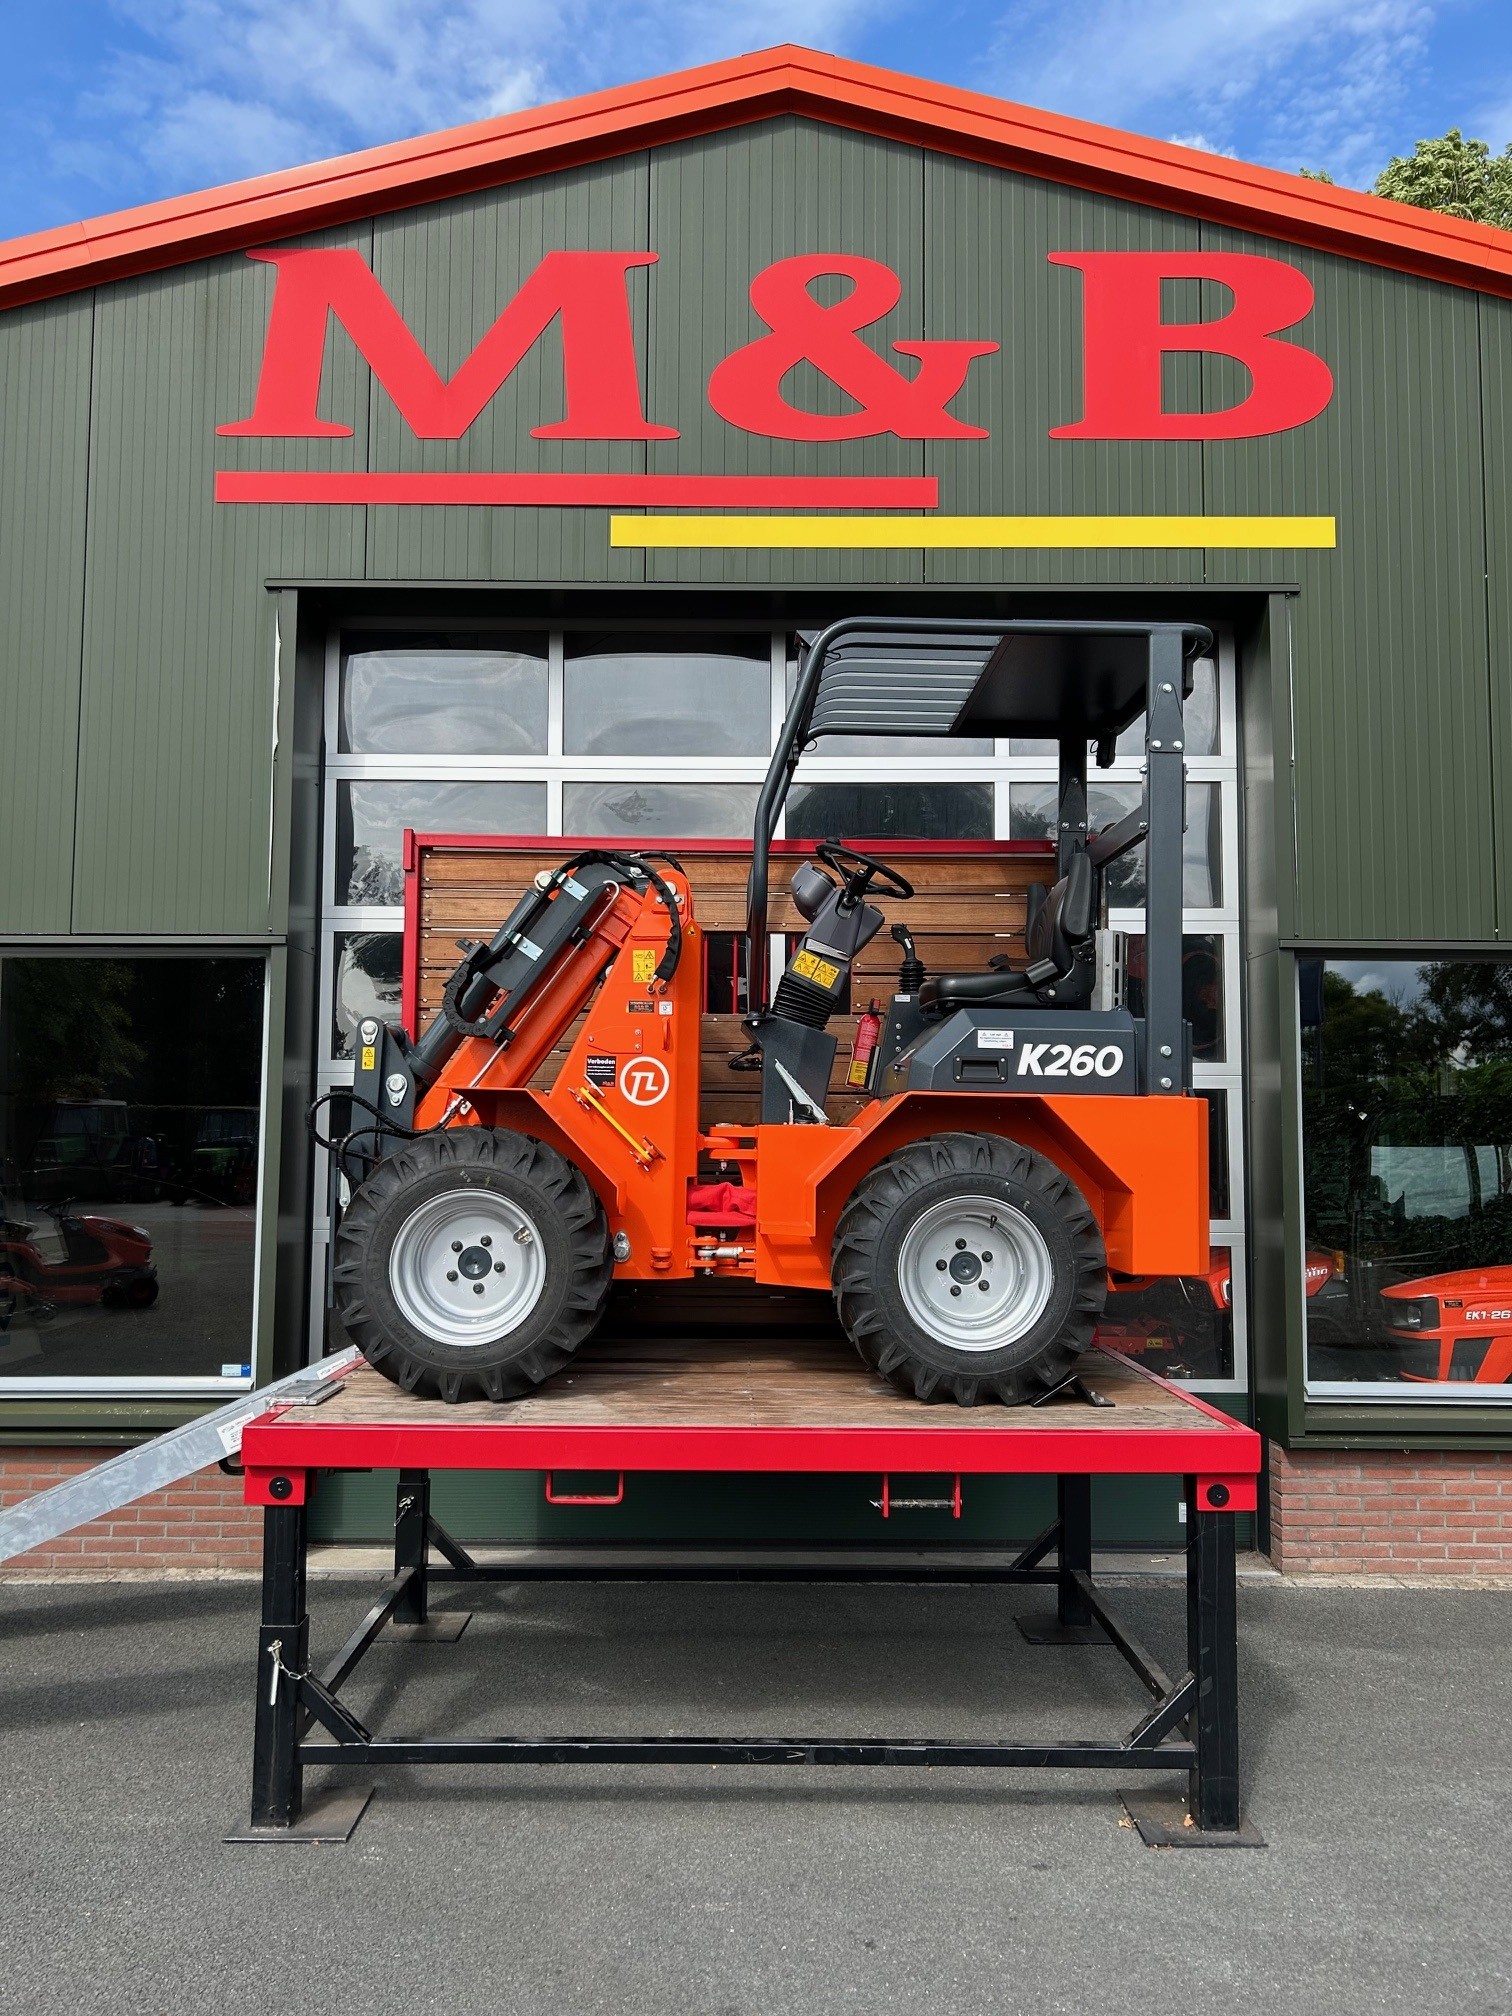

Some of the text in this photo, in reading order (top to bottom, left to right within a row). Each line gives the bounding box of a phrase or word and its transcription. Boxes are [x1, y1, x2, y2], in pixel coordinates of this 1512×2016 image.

[216, 249, 1335, 442] M & B
[1017, 1043, 1124, 1077] K260
